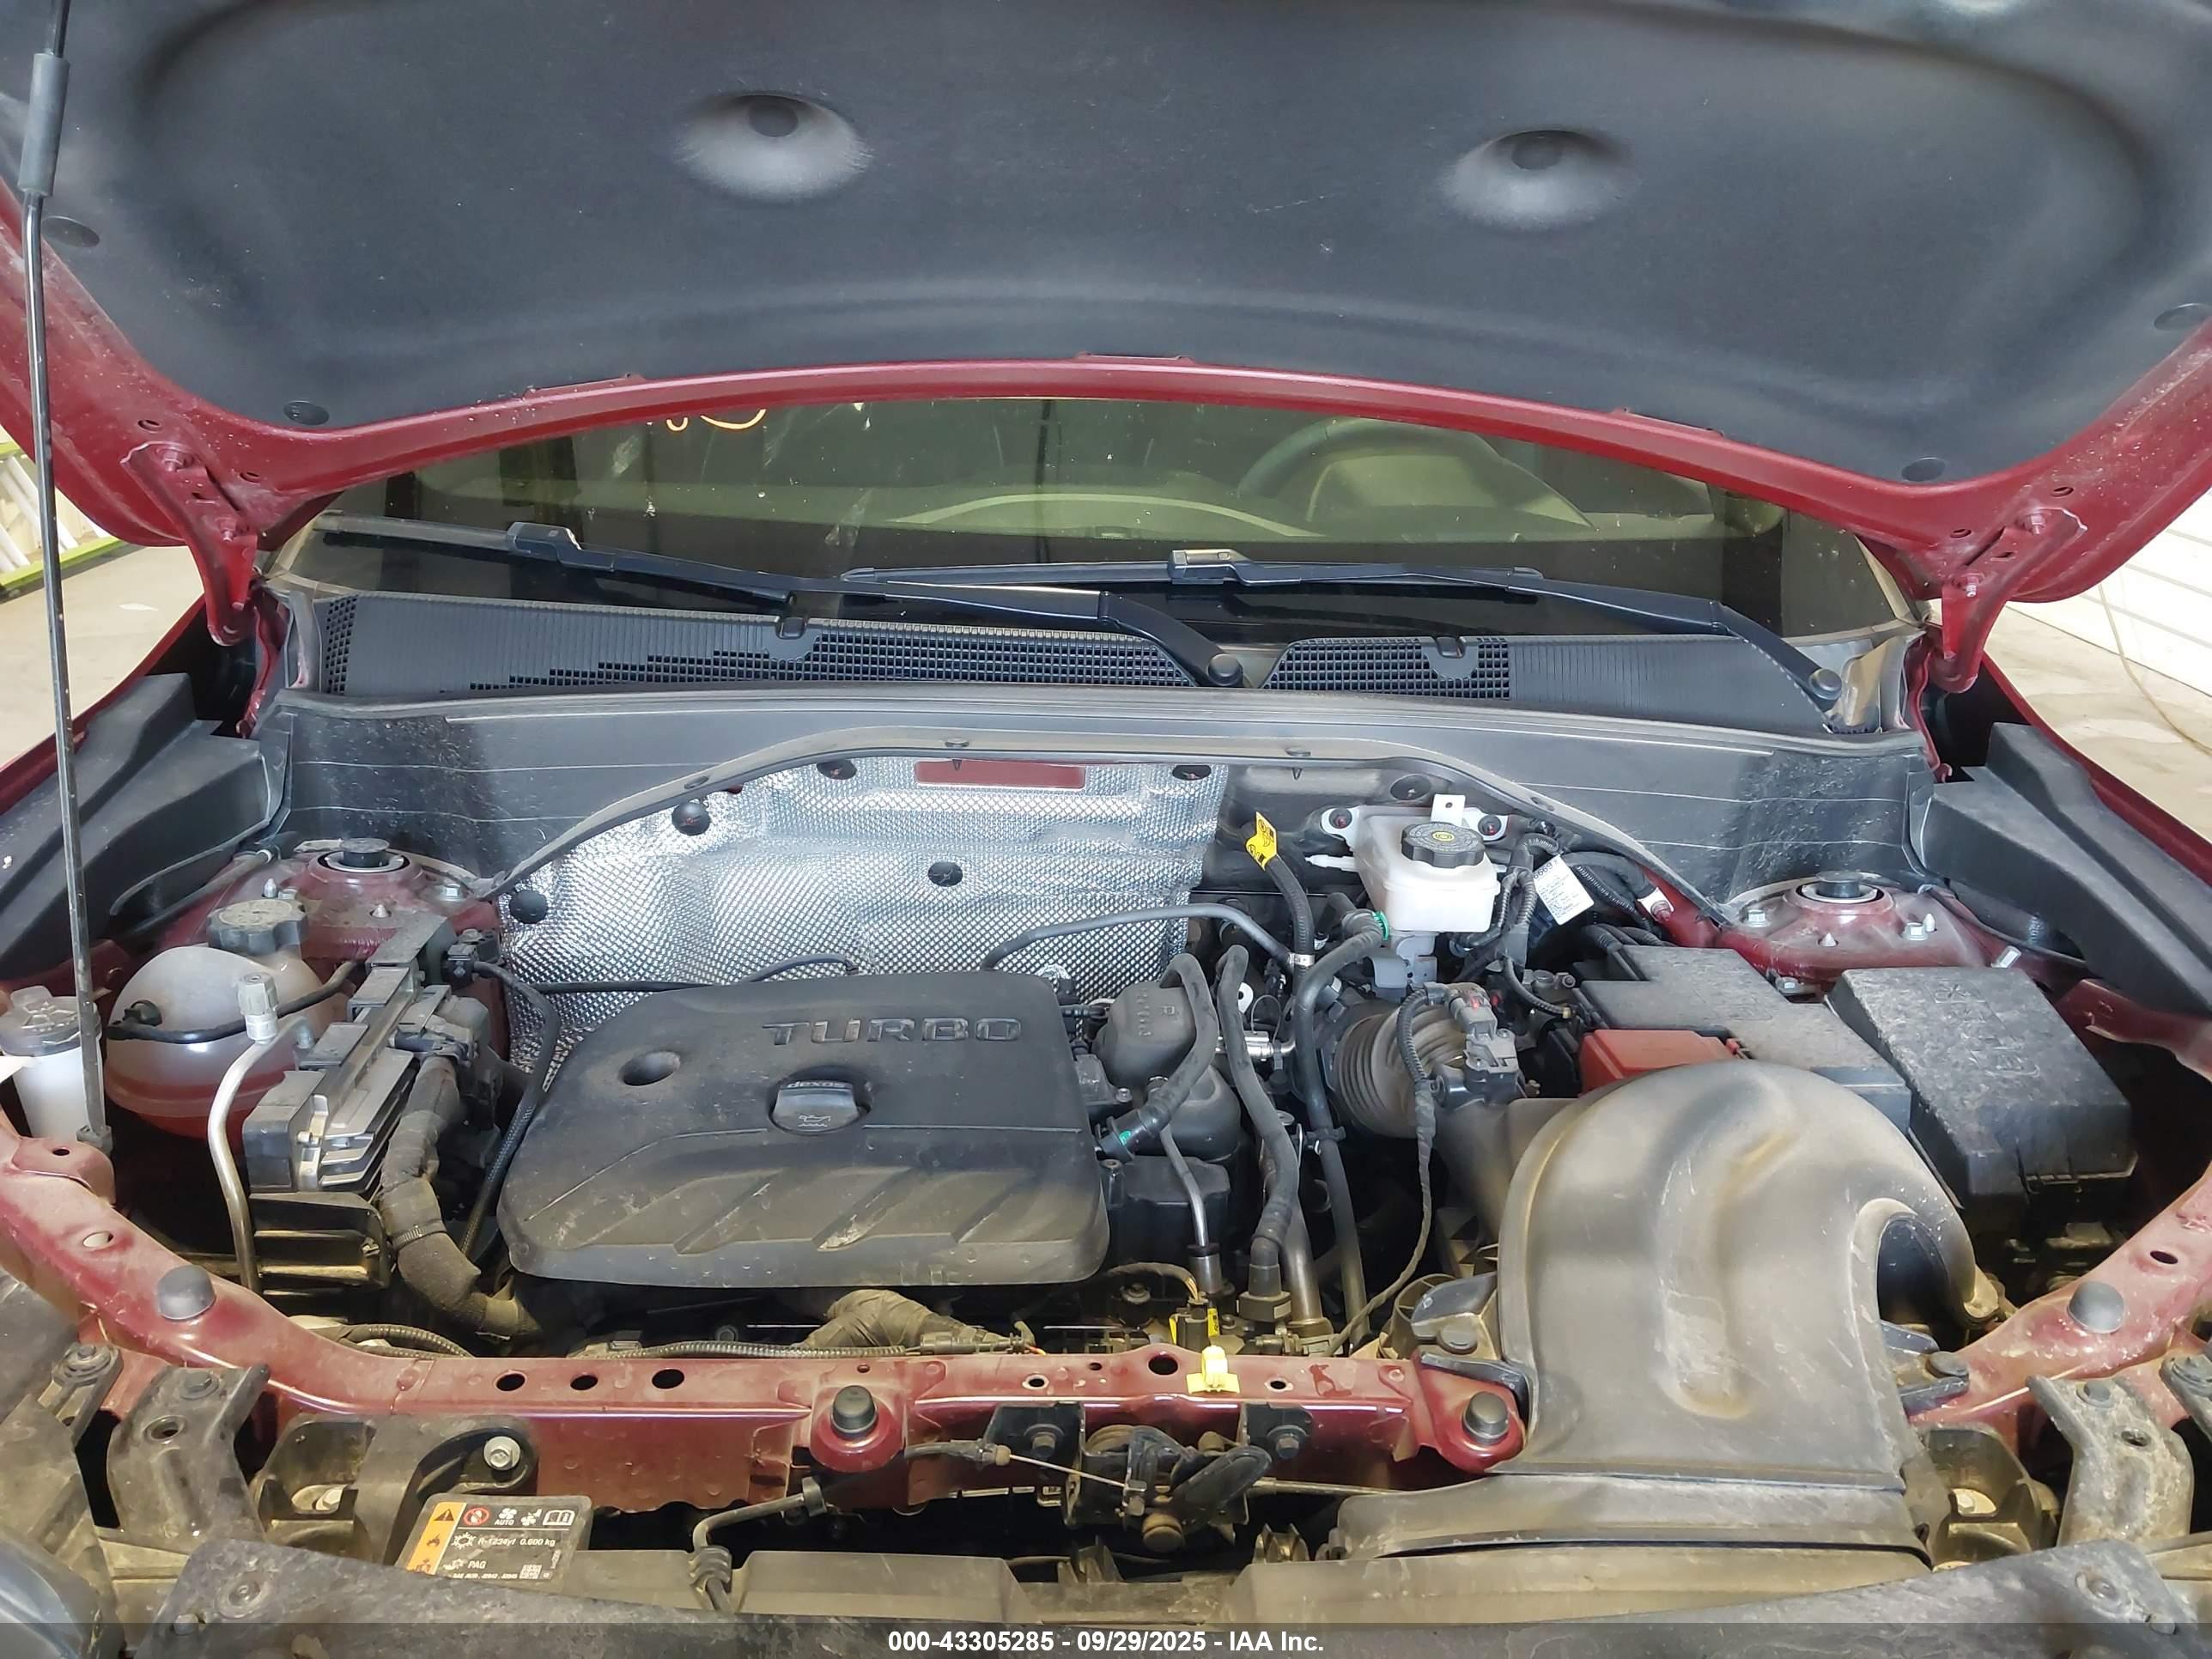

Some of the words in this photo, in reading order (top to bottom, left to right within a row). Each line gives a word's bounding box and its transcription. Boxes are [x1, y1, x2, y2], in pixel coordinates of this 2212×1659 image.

[763, 1017, 1022, 1046] TURBO
[544, 1538, 556, 1547] kg
[467, 1560, 487, 1570] PAG
